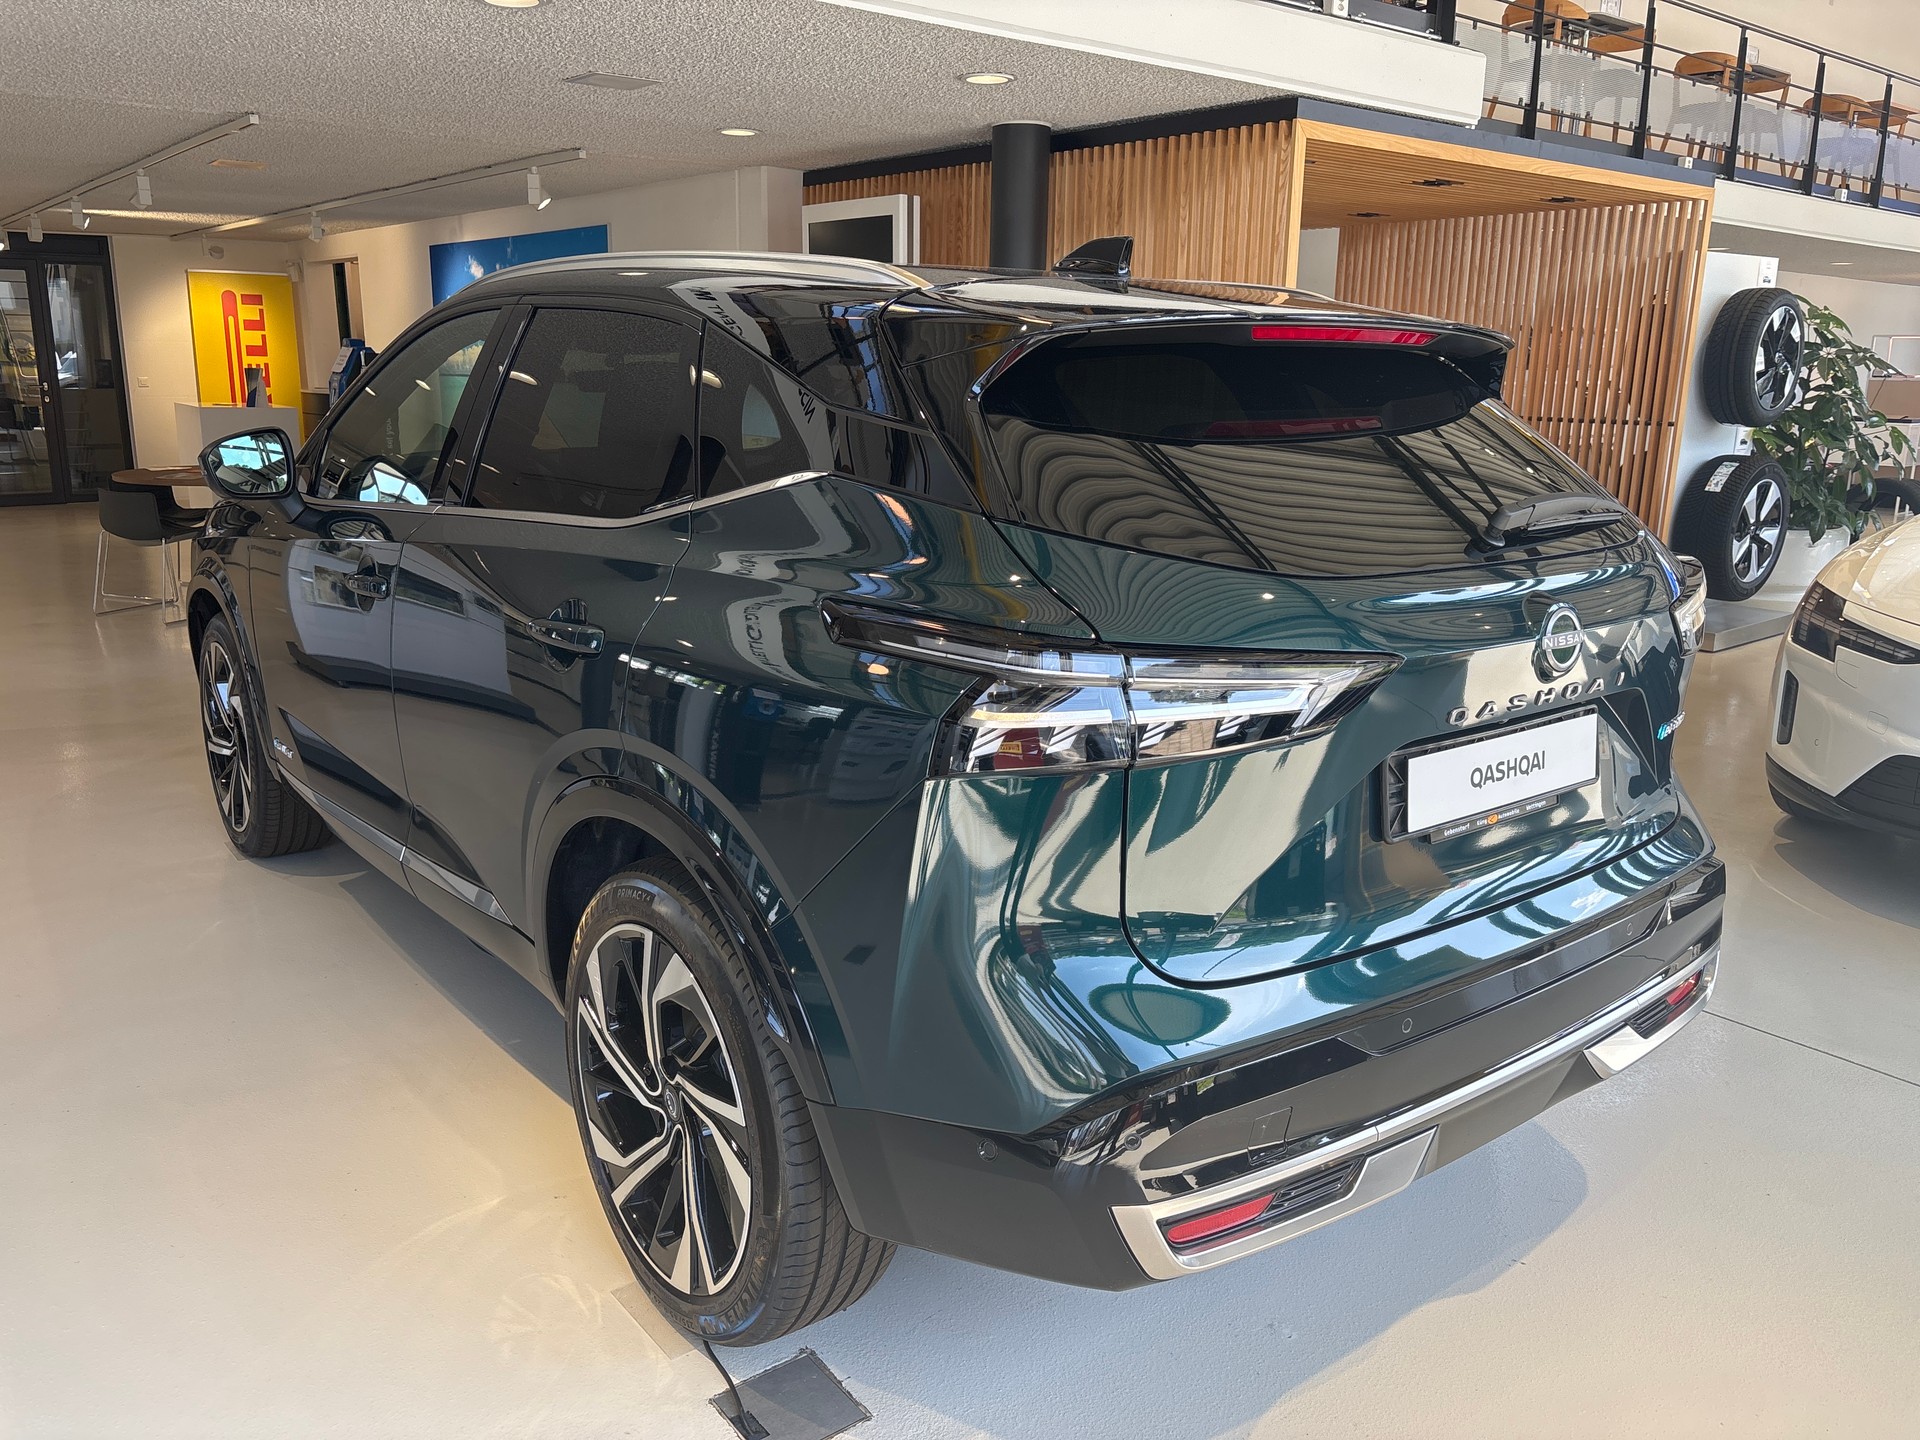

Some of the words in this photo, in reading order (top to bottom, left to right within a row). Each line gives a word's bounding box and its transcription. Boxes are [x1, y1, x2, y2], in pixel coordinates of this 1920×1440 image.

[1543, 632, 1585, 648] NISSAN
[1447, 670, 1626, 728] QASHQAI
[1470, 750, 1546, 789] QASHQAI
[617, 888, 647, 902] PRIMACY
